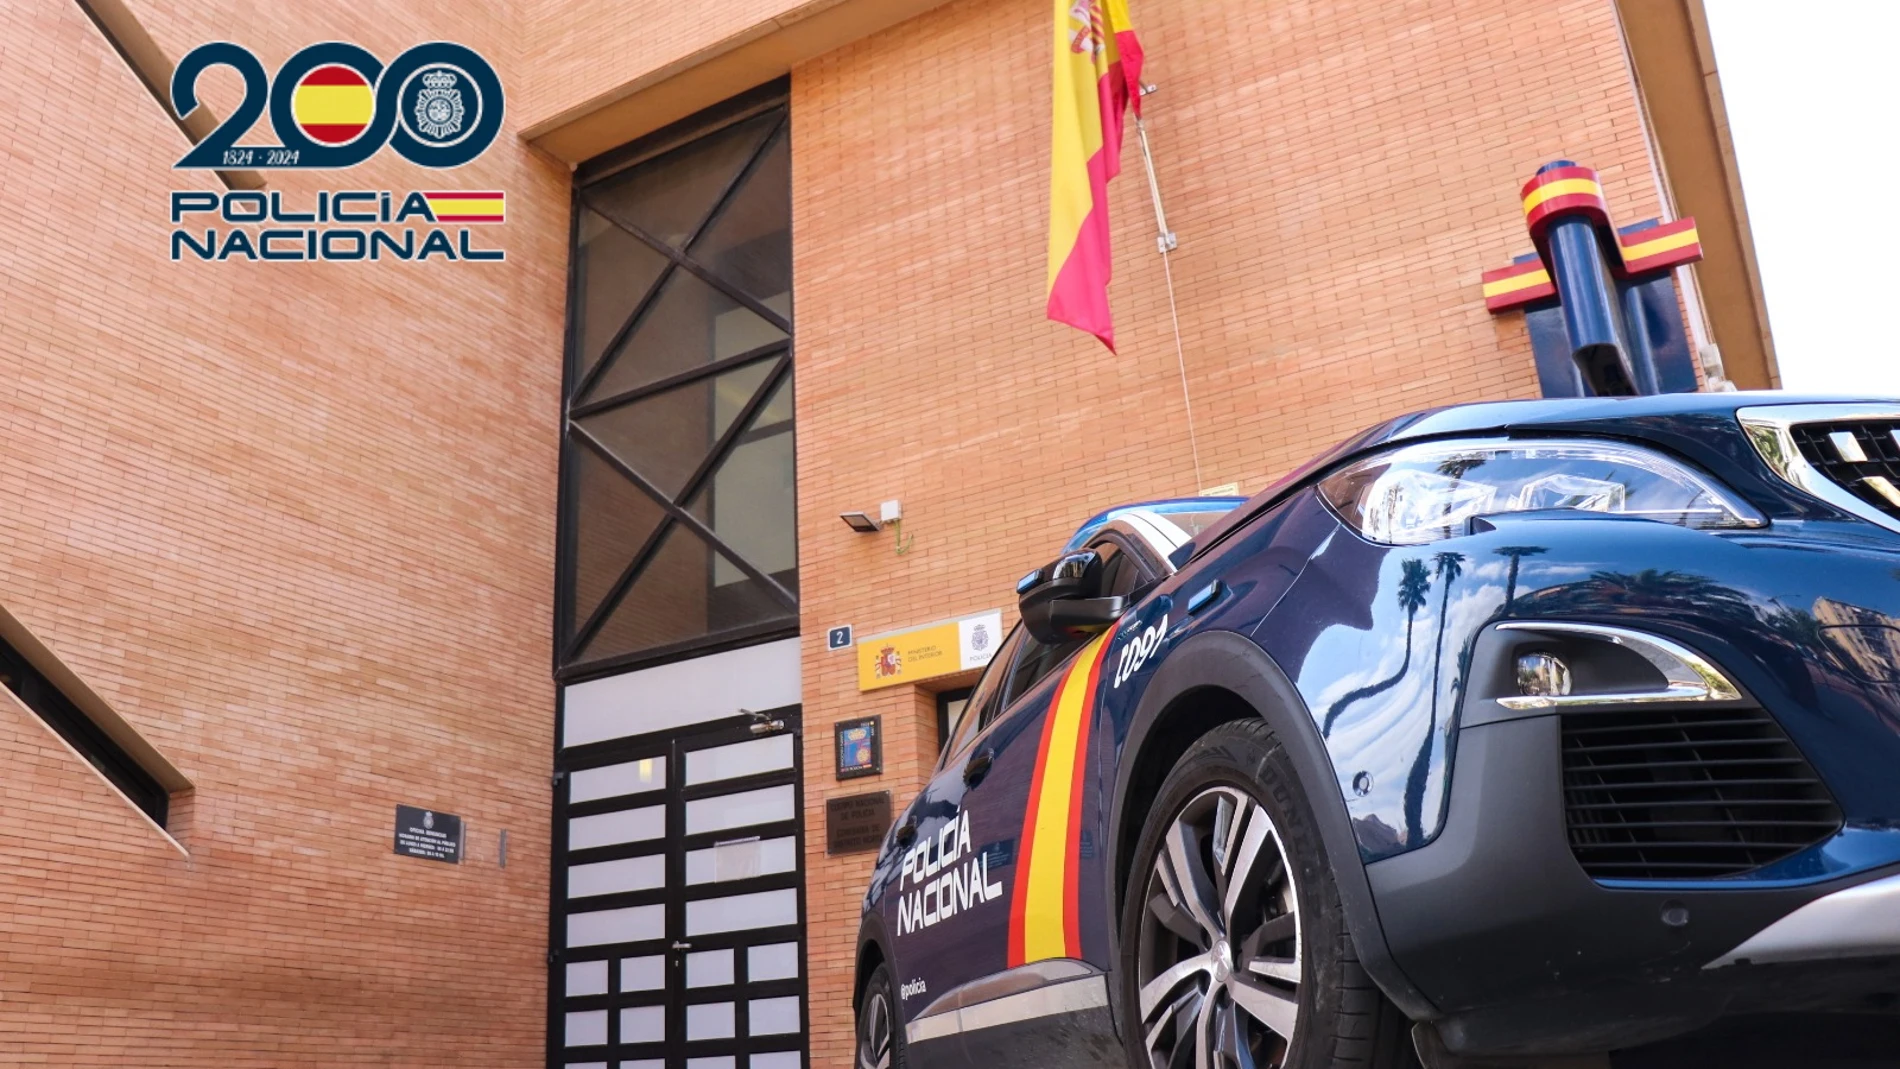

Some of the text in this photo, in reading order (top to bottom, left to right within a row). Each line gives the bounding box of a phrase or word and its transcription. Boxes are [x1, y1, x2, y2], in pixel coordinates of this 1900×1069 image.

[836, 631, 844, 645] 2
[1114, 613, 1168, 689] 1091
[897, 852, 1003, 937] NACIONAL
